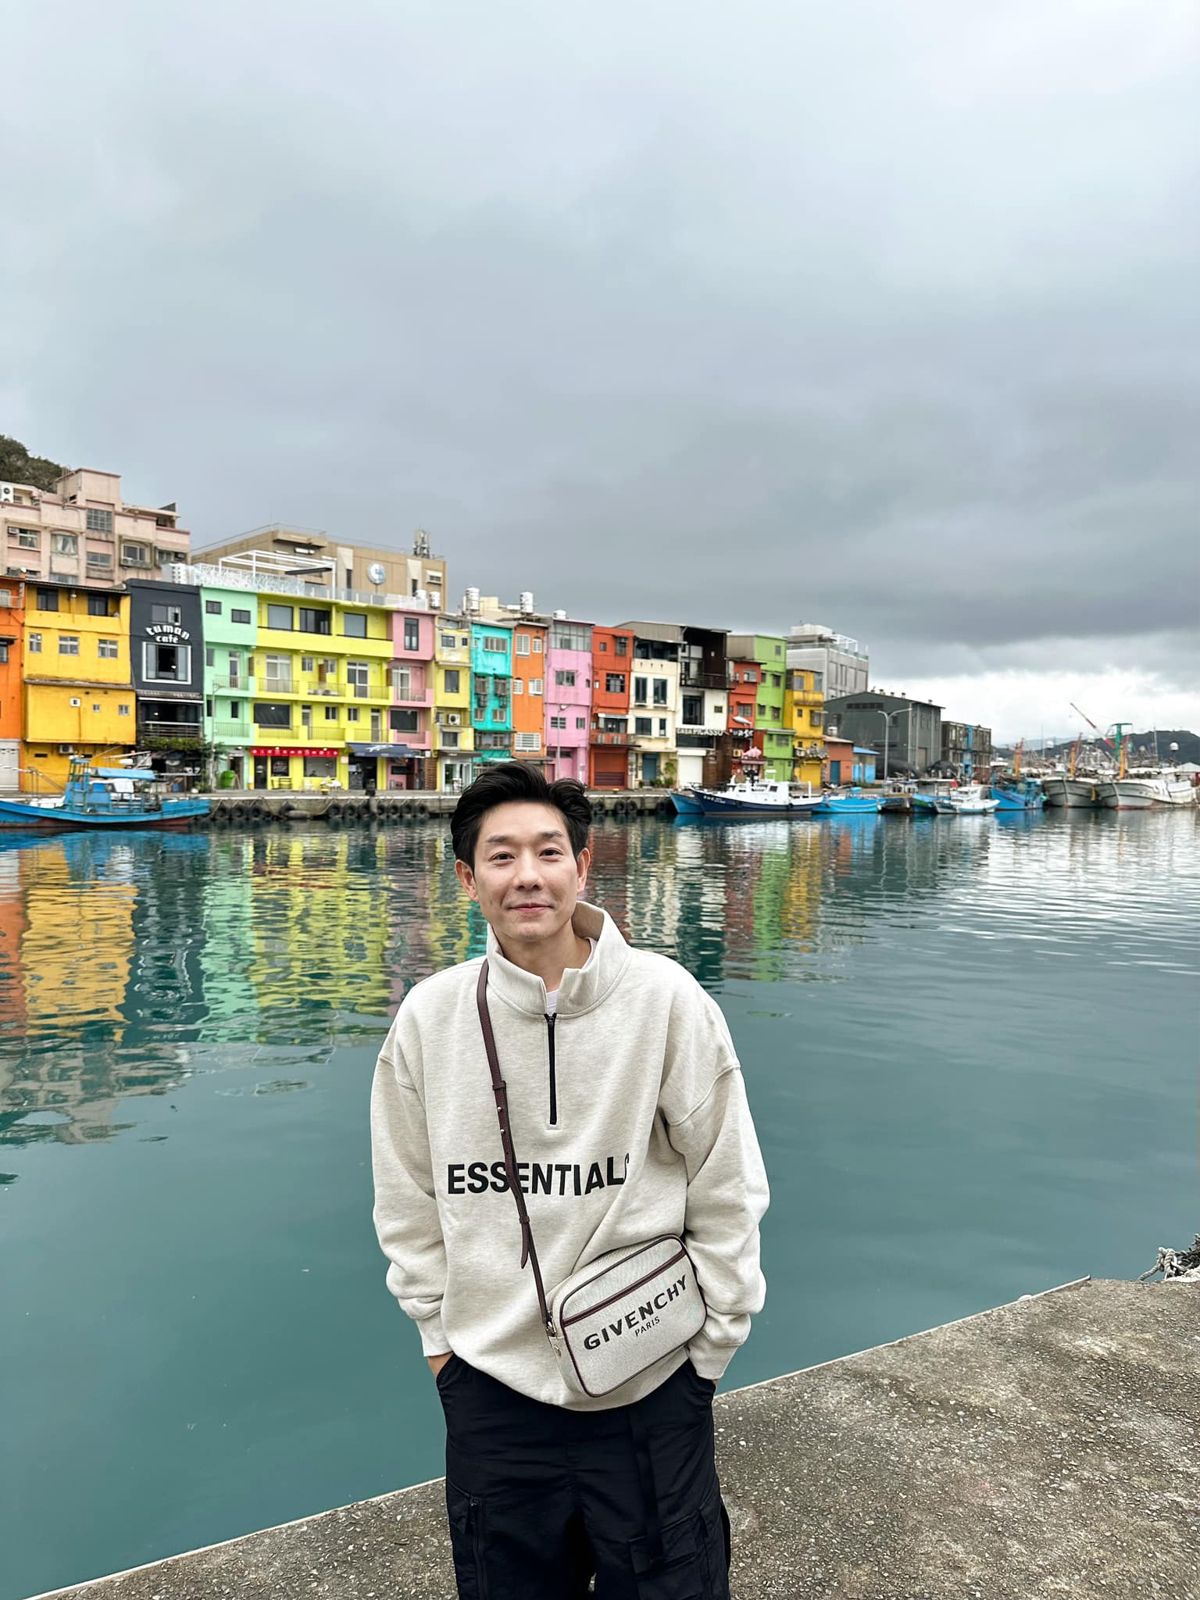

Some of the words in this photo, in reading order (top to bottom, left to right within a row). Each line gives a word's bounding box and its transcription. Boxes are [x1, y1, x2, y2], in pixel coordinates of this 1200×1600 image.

[145, 625, 190, 640] tuman
[583, 1275, 688, 1351] GIVENCHY
[634, 1316, 661, 1337] PARIS
